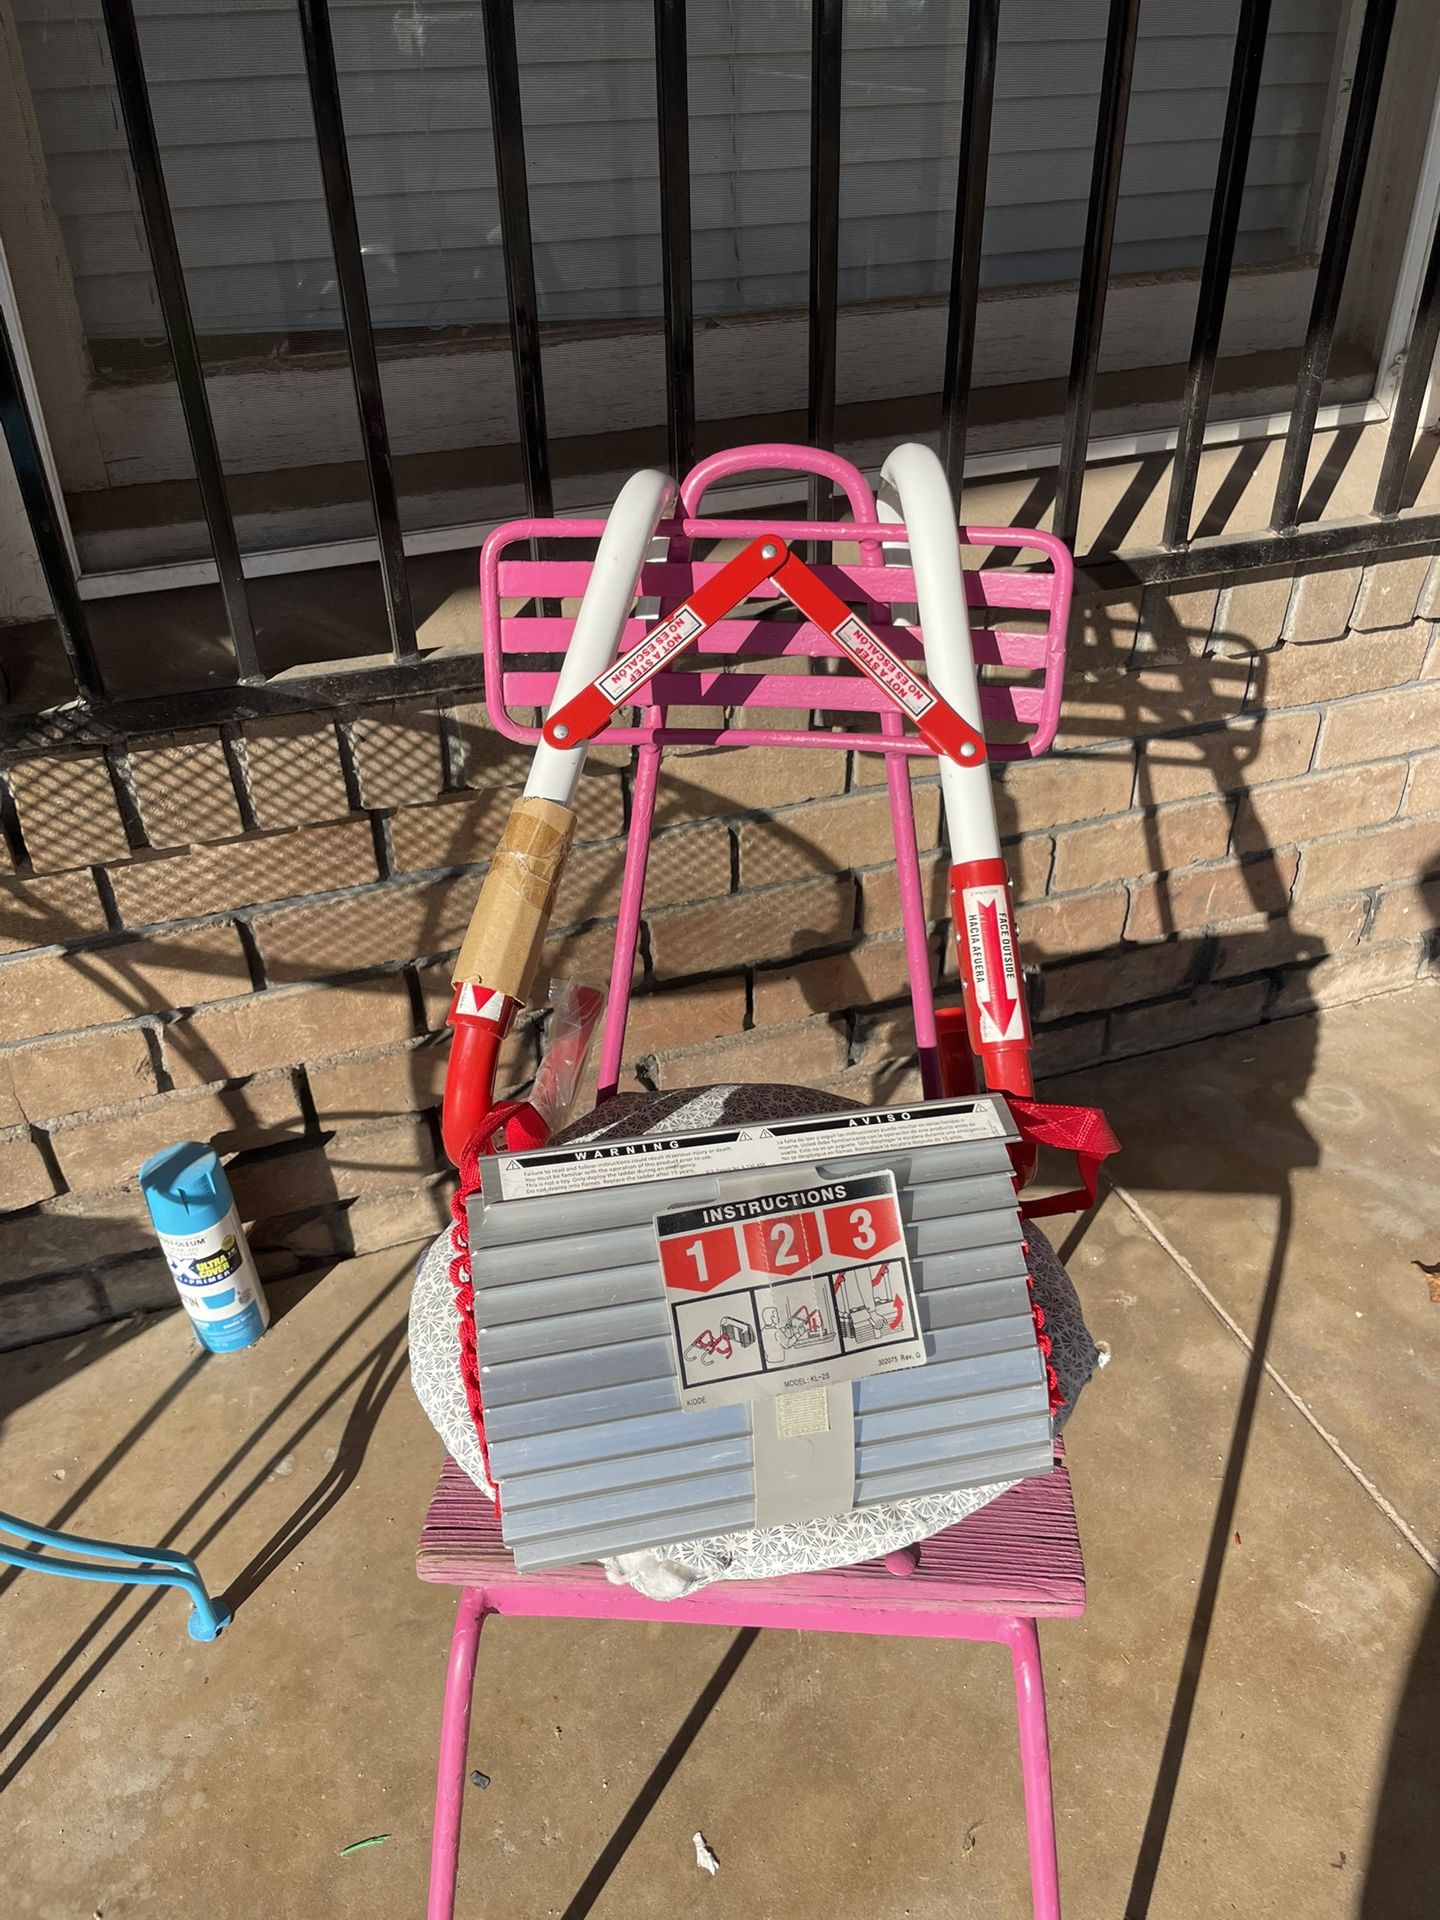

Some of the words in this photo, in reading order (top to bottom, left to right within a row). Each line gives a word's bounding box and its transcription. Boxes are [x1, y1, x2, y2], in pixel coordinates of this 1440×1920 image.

[668, 618, 685, 633] NO
[655, 631, 669, 645] ES
[662, 633, 682, 653] NOT
[611, 643, 656, 684] ESCALÓN
[855, 647, 881, 670] STEP
[629, 659, 654, 682] STEP
[895, 671, 909, 686] ES
[886, 678, 907, 698] NOT
[908, 685, 924, 700] NO
[968, 914, 981, 944] HACIA
[998, 912, 1009, 937] FACE
[972, 946, 985, 984] AFUERA
[1002, 938, 1016, 979] OUTSIDE
[848, 1112, 912, 1128] AVISO
[575, 1140, 680, 1161] WARNING
[703, 1186, 847, 1224] INSTRUCTIONS
[686, 1240, 709, 1282] 1
[770, 1223, 800, 1267] 2
[849, 1208, 876, 1251] 3
[195, 1254, 227, 1271] ULTRA
[198, 1261, 230, 1278] COVER
[784, 1376, 810, 1388] MODEL:
[686, 1396, 706, 1406] KIDDE
